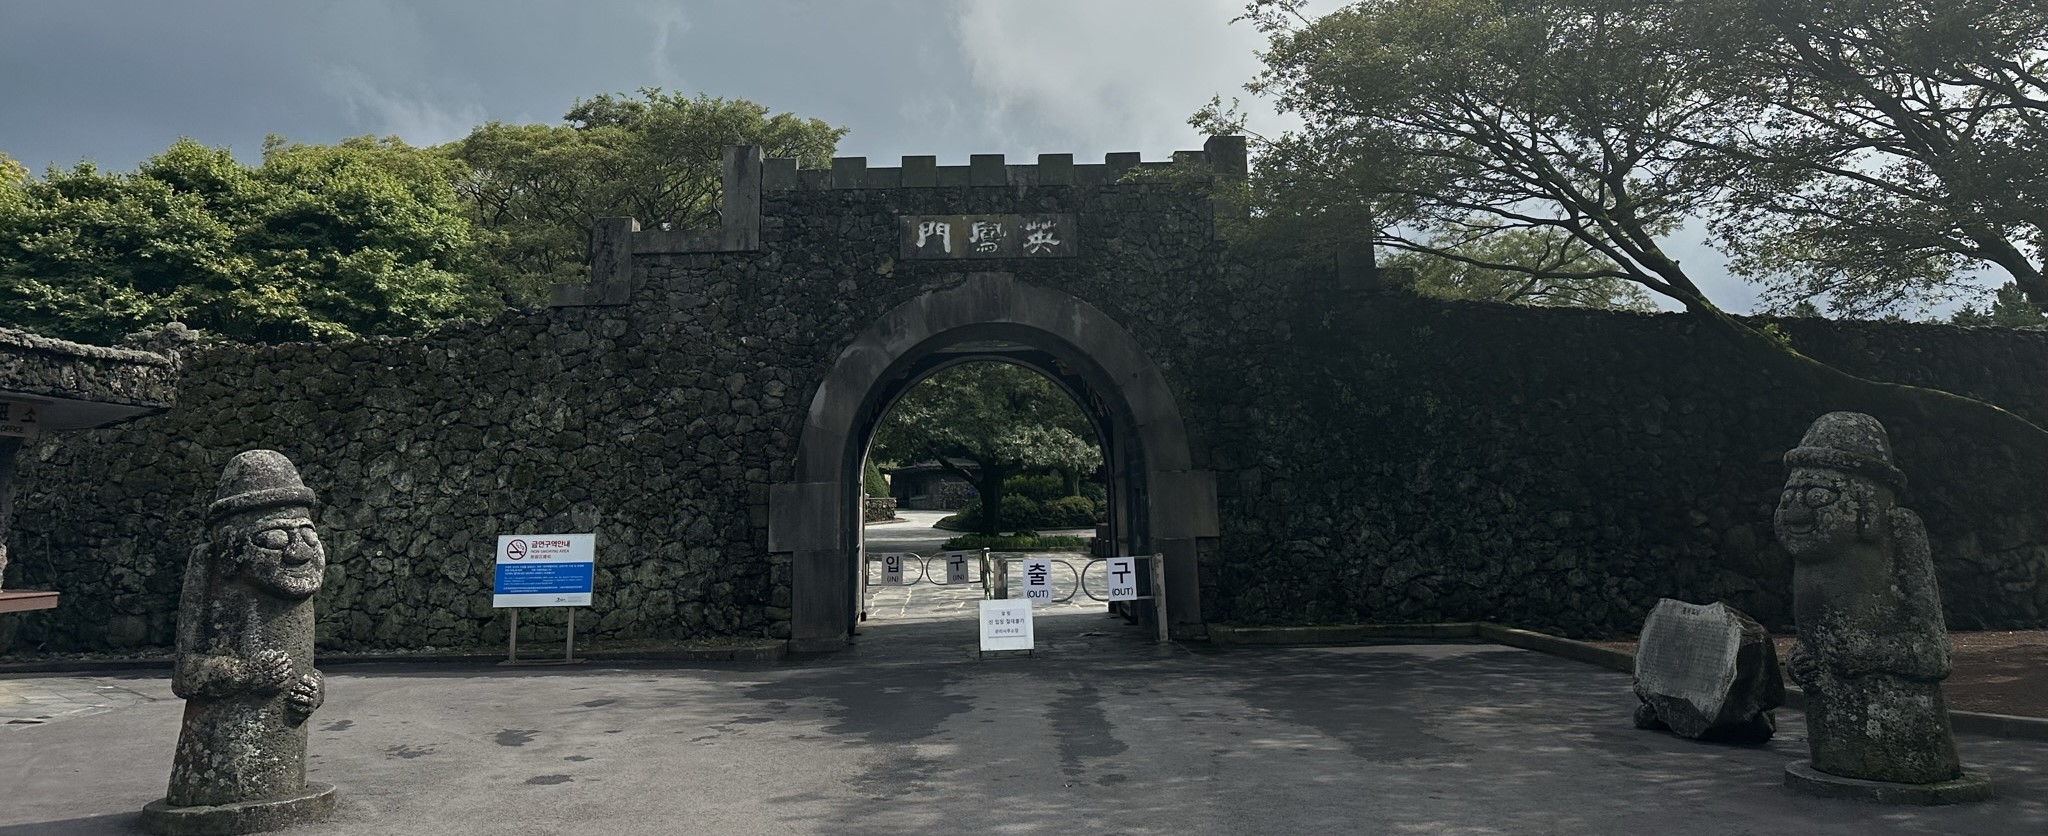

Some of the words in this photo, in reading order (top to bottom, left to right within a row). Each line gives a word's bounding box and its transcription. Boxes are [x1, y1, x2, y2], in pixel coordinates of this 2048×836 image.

[886, 556, 900, 573] 입
[950, 554, 965, 571] 구
[887, 575, 899, 583] (IN)
[1027, 563, 1047, 586] 출
[1112, 562, 1131, 584] 구
[1026, 590, 1049, 599] (OUT)
[1112, 587, 1134, 596] (OUT)
